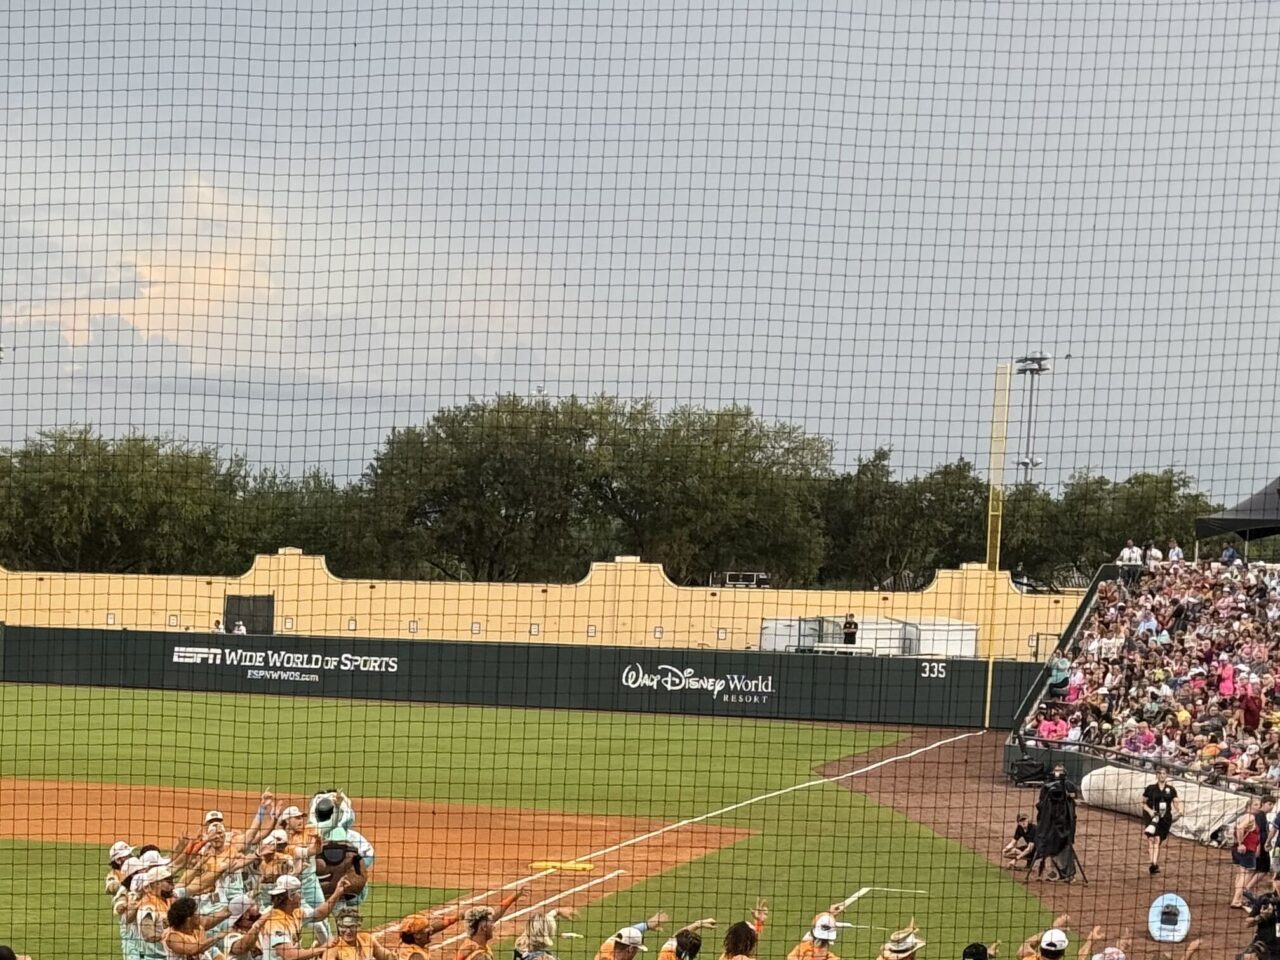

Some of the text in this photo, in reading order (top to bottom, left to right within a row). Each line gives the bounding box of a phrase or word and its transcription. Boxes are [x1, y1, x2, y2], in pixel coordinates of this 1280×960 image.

[172, 646, 398, 672] ESPN WIDE WORLD OF SPORTS
[246, 669, 319, 683] ESPNWWOS.com
[921, 662, 947, 678] 335
[726, 674, 772, 693] World
[723, 694, 769, 704] RESORT
